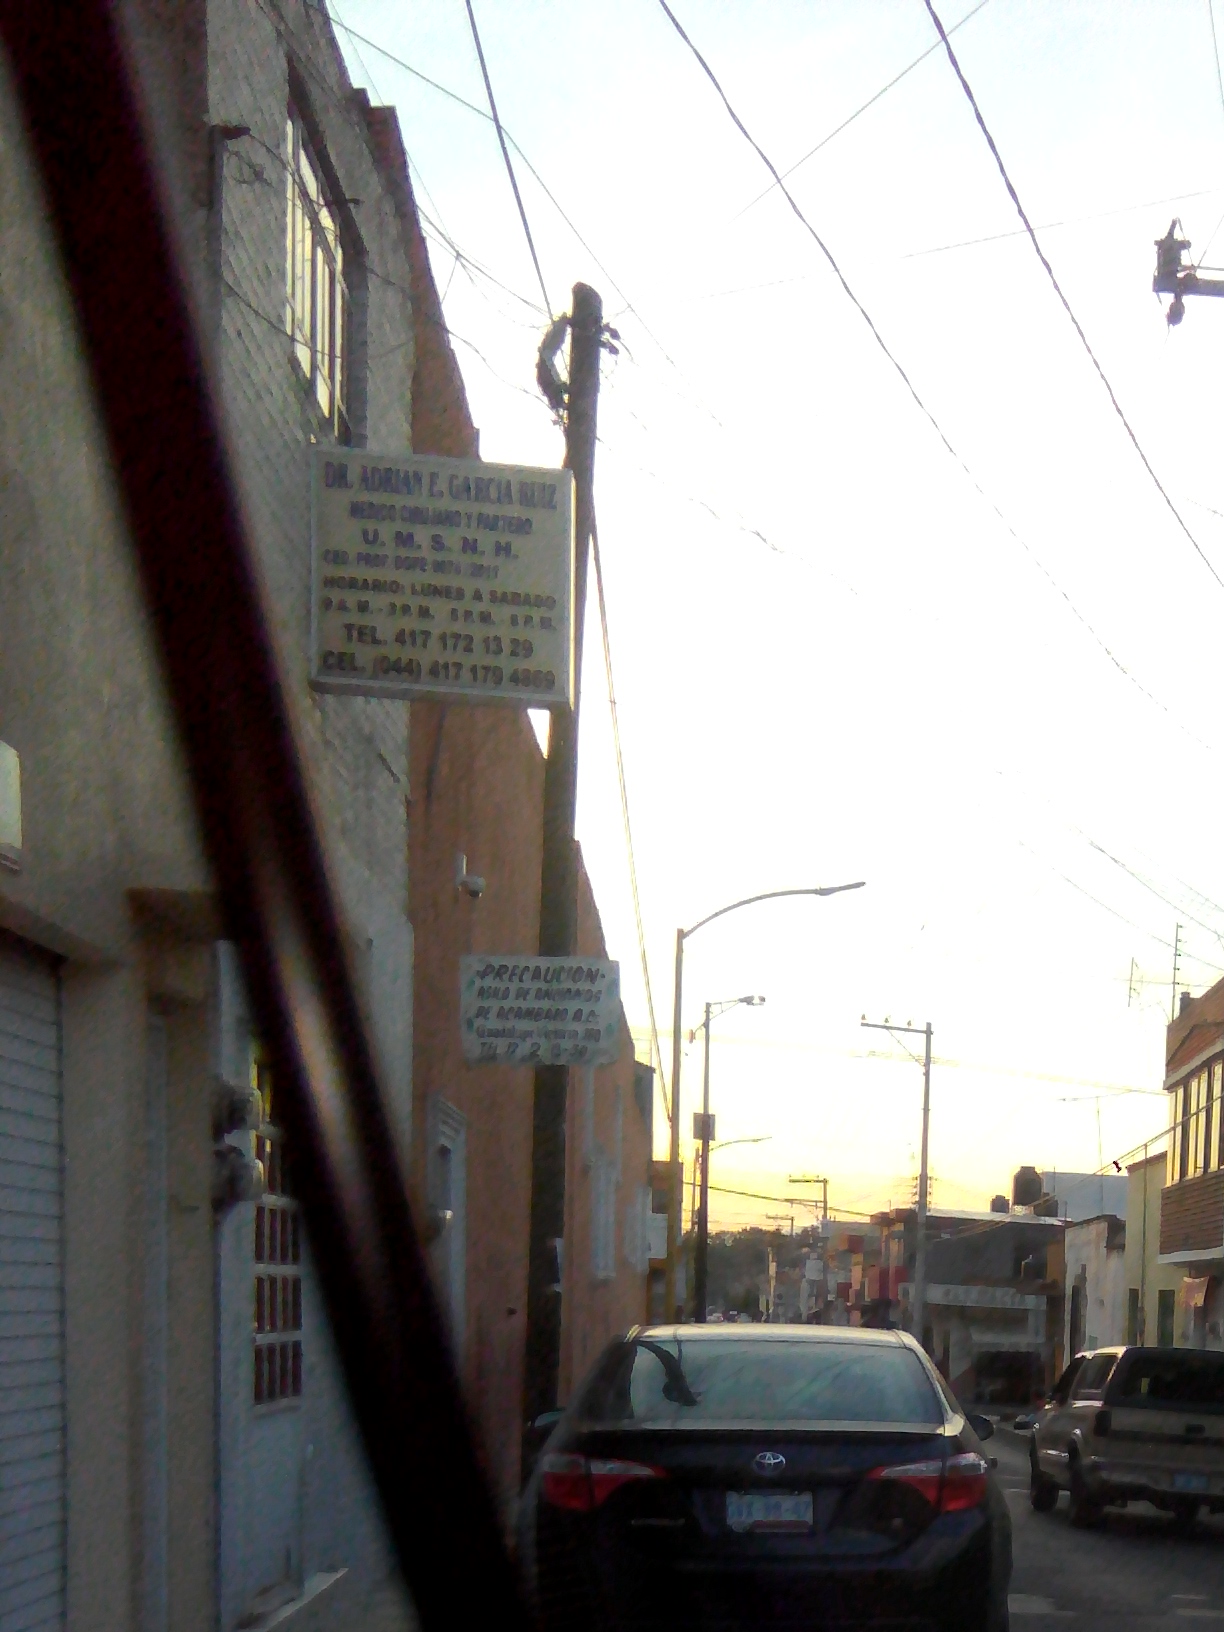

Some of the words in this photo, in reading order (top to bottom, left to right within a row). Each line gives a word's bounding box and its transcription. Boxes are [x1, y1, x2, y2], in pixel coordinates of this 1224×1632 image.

[325, 461, 353, 489] DR.
[360, 465, 423, 496] ADRIAN
[448, 474, 514, 505] GARCIA
[350, 500, 397, 521] MEDICO
[465, 512, 474, 529] Y
[477, 513, 533, 535] PARTERO
[411, 582, 465, 601] LUNES
[473, 587, 484, 603] A
[343, 622, 387, 645] TEL.
[395, 628, 431, 649] 417
[439, 631, 474, 653] 172
[323, 650, 366, 671] CEL.
[429, 660, 463, 681] 417
[515, 987, 533, 1001] DE
